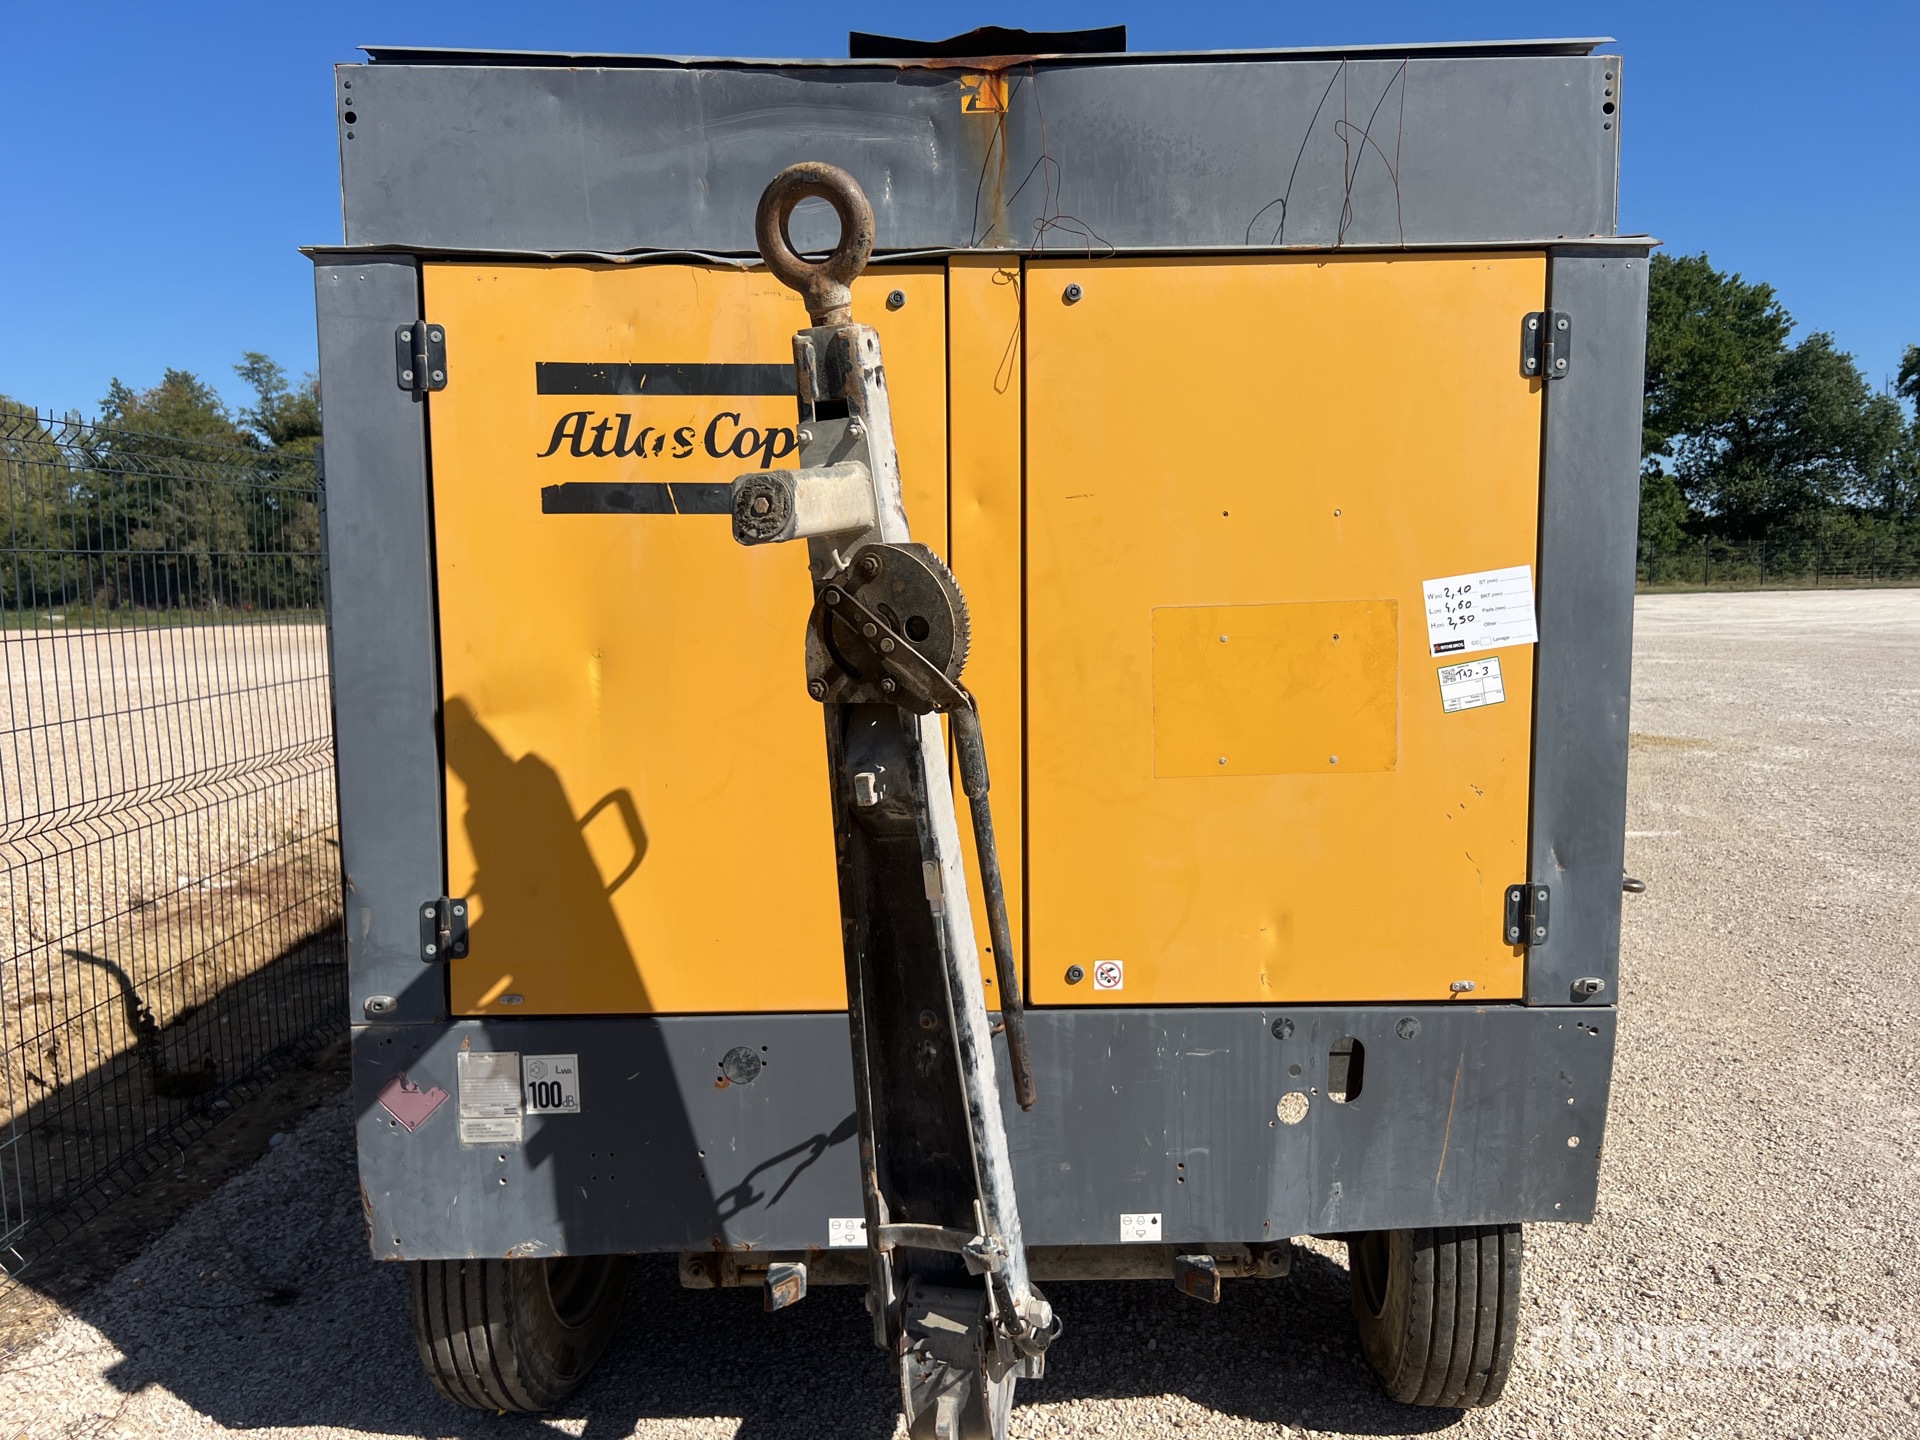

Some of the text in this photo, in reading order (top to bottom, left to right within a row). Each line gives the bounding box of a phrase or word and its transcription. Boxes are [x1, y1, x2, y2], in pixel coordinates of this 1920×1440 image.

[537, 411, 798, 468] Atlas Cop
[1444, 584, 1472, 600] 2,10
[1444, 599, 1472, 614] 4,60
[1447, 614, 1475, 630] 2,50
[1482, 666, 1489, 676] 3
[528, 1080, 562, 1109] 100
[562, 1095, 575, 1108] dB
